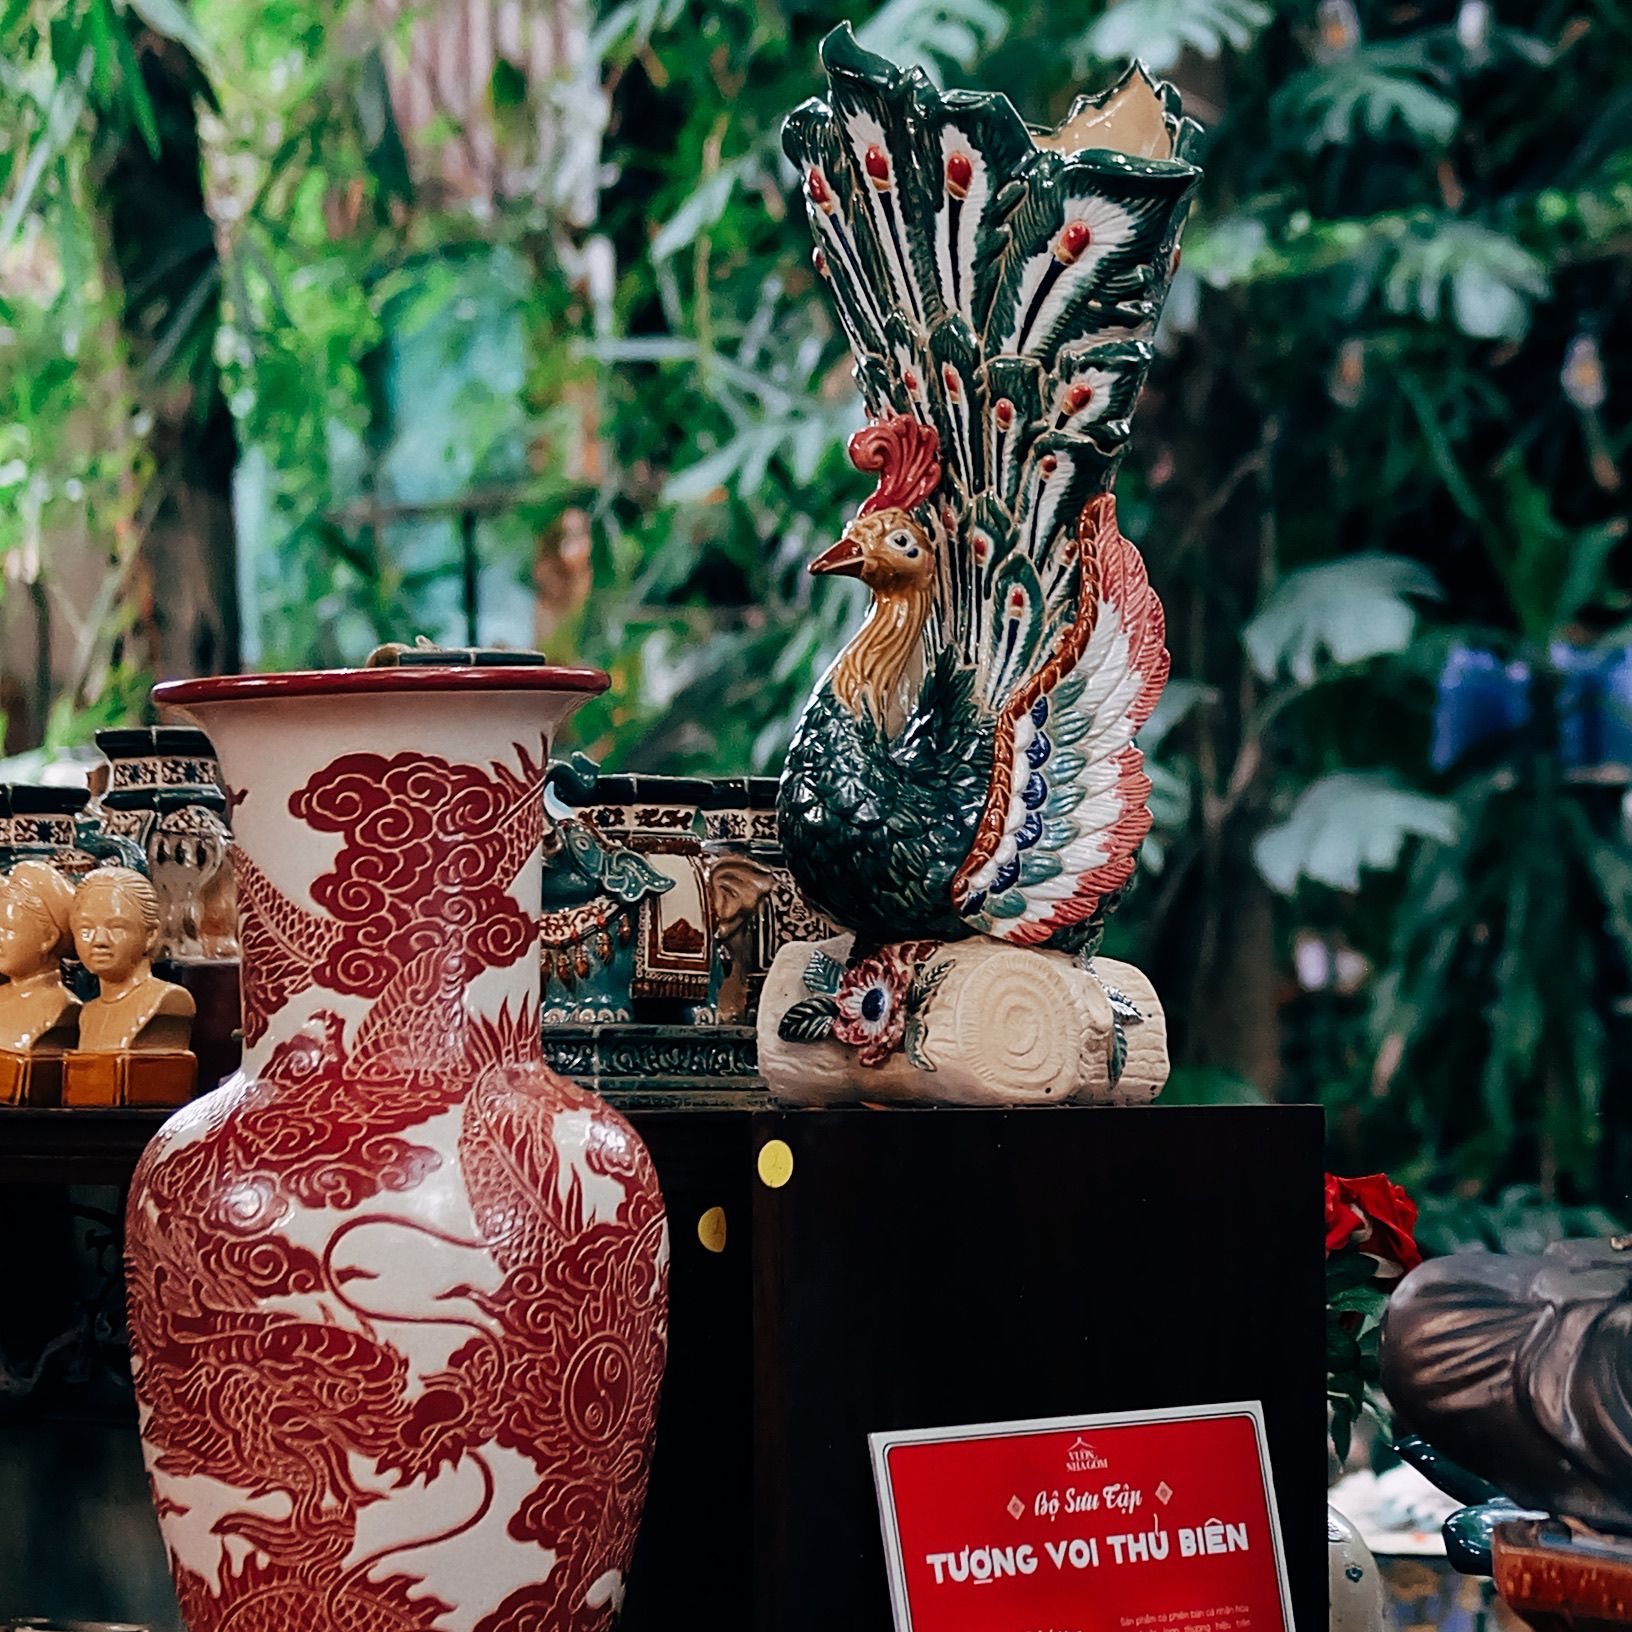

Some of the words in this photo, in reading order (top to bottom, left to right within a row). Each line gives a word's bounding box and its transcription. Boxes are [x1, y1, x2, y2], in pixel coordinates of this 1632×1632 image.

[1034, 1490, 1061, 1522] Bộ
[1102, 1482, 1143, 1515] Tập
[925, 1543, 1039, 1586] TƯỢNG
[1043, 1537, 1101, 1571] VOI
[1177, 1517, 1250, 1558] BIÊN
